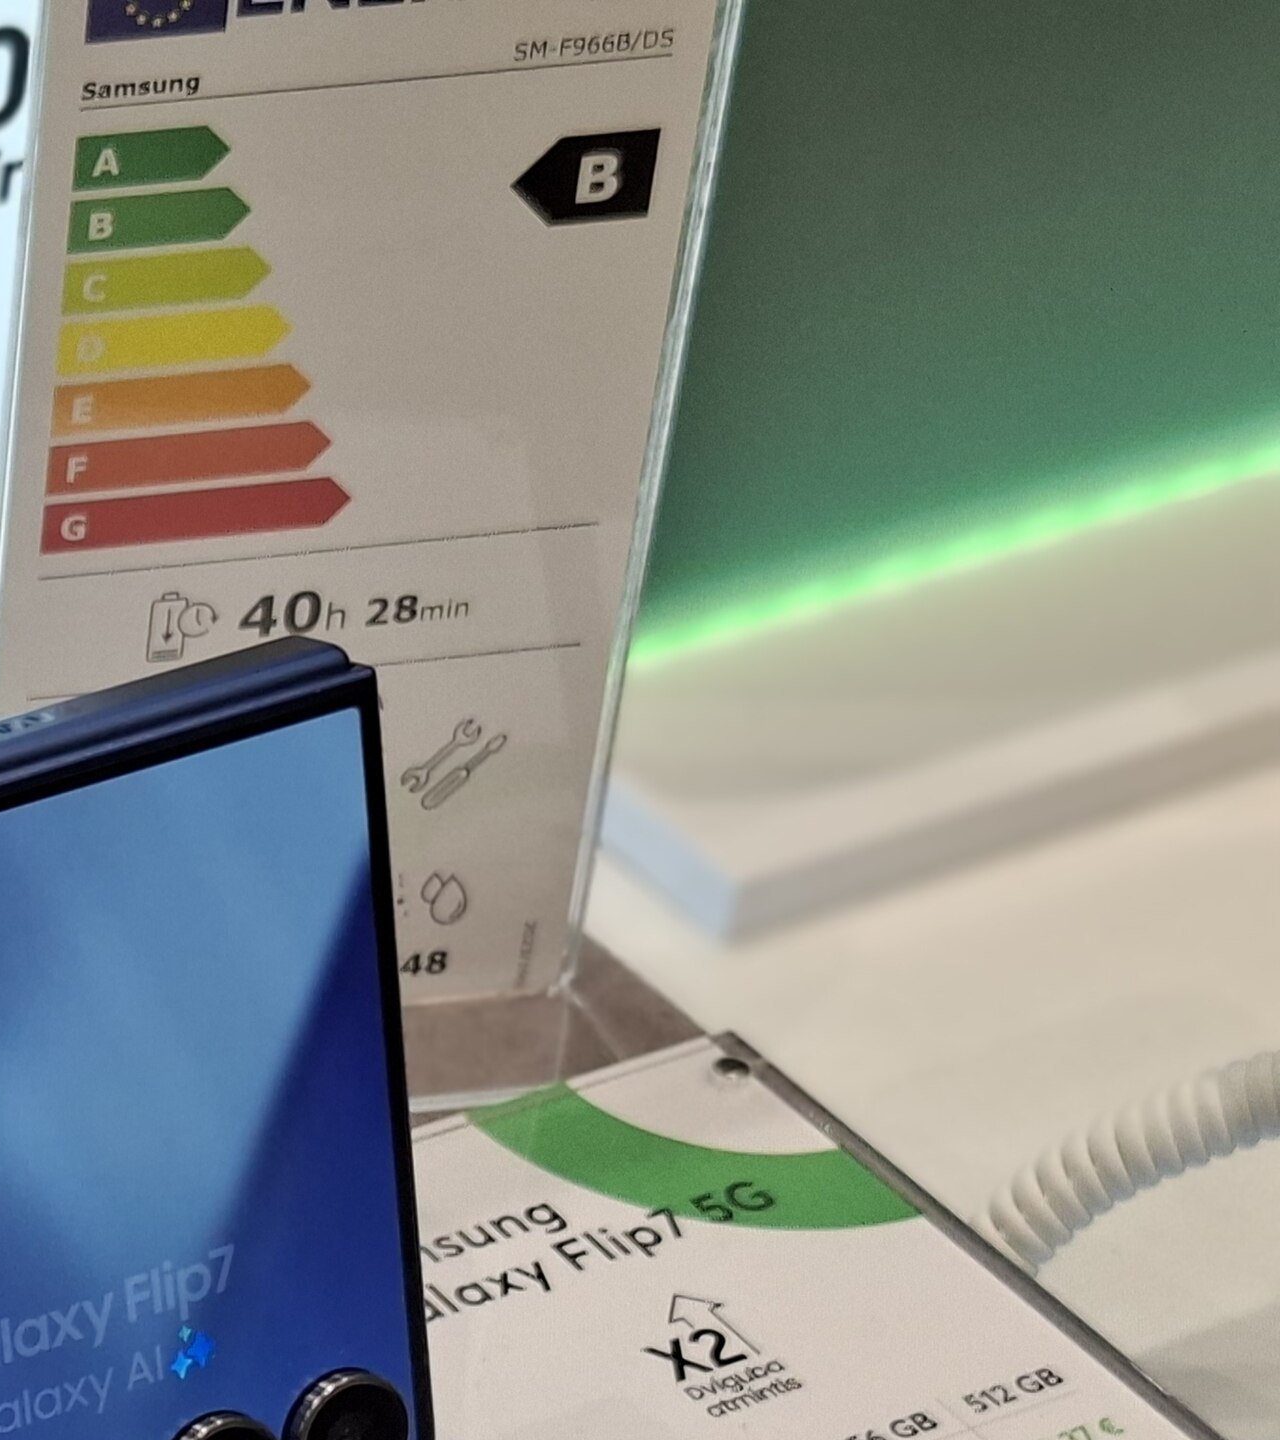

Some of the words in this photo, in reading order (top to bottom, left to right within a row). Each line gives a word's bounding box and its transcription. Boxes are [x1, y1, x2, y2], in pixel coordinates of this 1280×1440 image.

[513, 28, 675, 62] SM-F966B/DS
[81, 72, 200, 101] Samsung
[92, 147, 120, 178] A
[574, 153, 624, 205] B
[87, 211, 114, 242] B
[82, 273, 108, 303] C
[76, 333, 105, 363] D
[70, 396, 94, 426] E
[65, 455, 89, 484] F
[59, 514, 88, 542] G
[550, 1207, 685, 1271] Flip7
[688, 1180, 778, 1225] 5G
[123, 1244, 235, 1324] Flip7
[125, 1345, 164, 1391] AI
[643, 1328, 748, 1384] X2
[706, 1377, 803, 1418] atmintis
[889, 1411, 939, 1440] GB
[962, 1384, 1015, 1414] 512
[1016, 1368, 1065, 1396] GB
[1098, 1416, 1126, 1440] €
